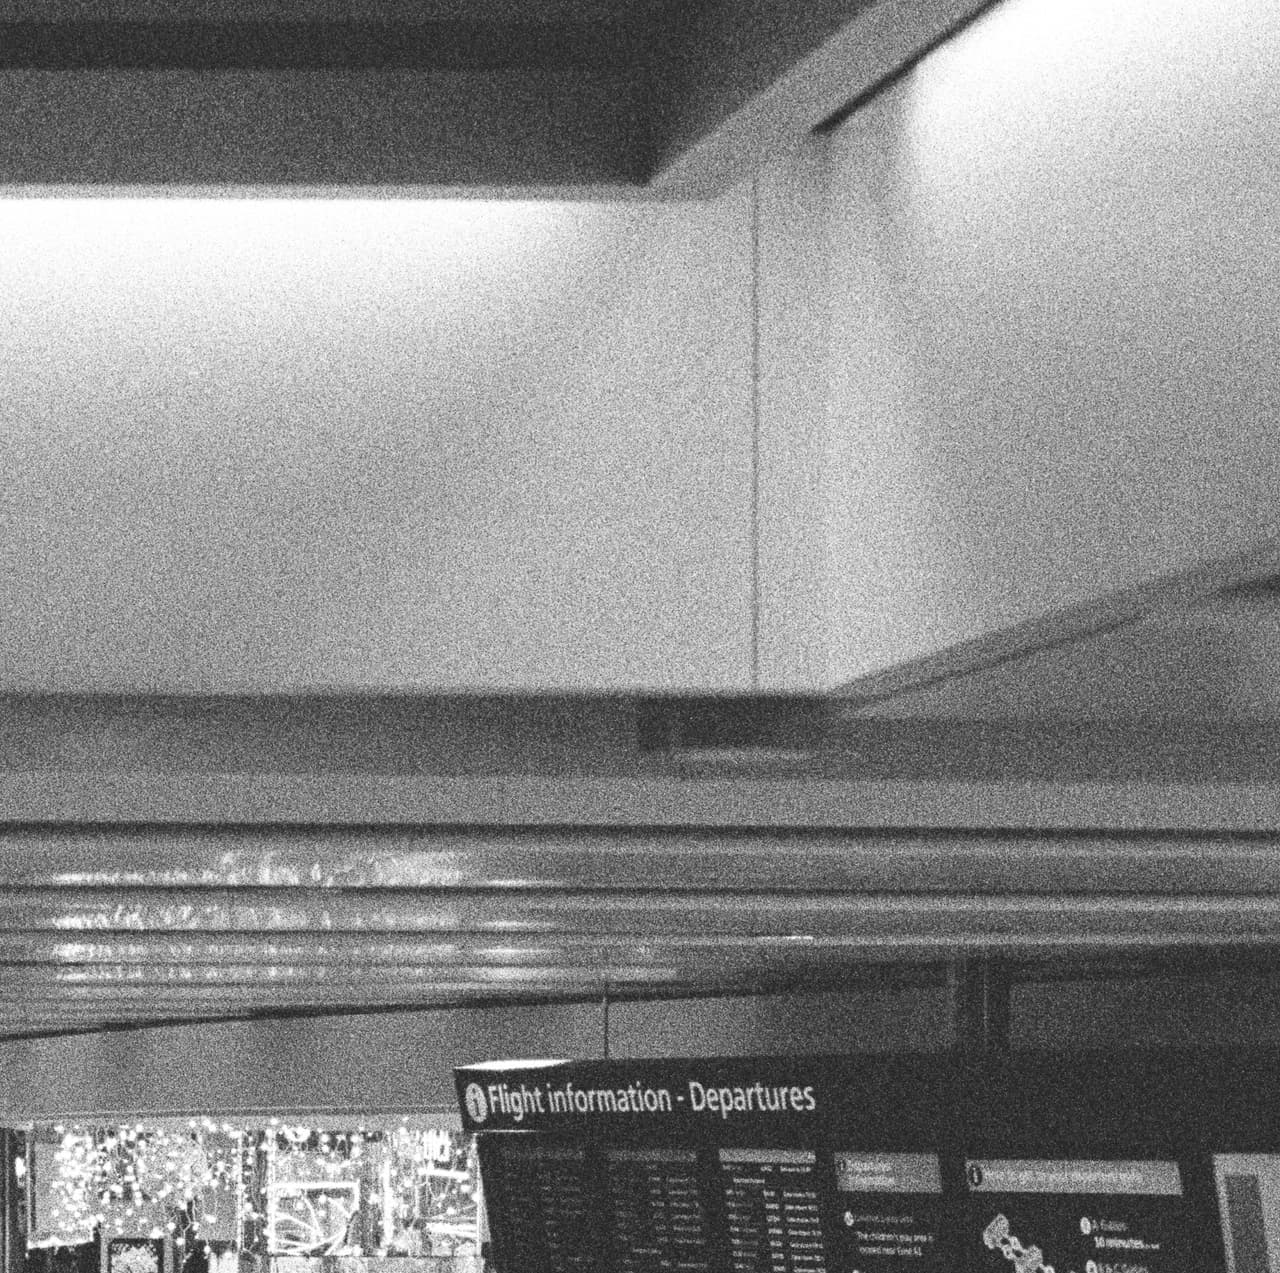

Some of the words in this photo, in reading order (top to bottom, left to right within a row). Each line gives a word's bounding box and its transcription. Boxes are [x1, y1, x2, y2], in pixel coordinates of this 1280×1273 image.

[487, 1083, 545, 1121] Flight
[547, 1081, 673, 1113] information
[689, 1081, 817, 1120] Departures
